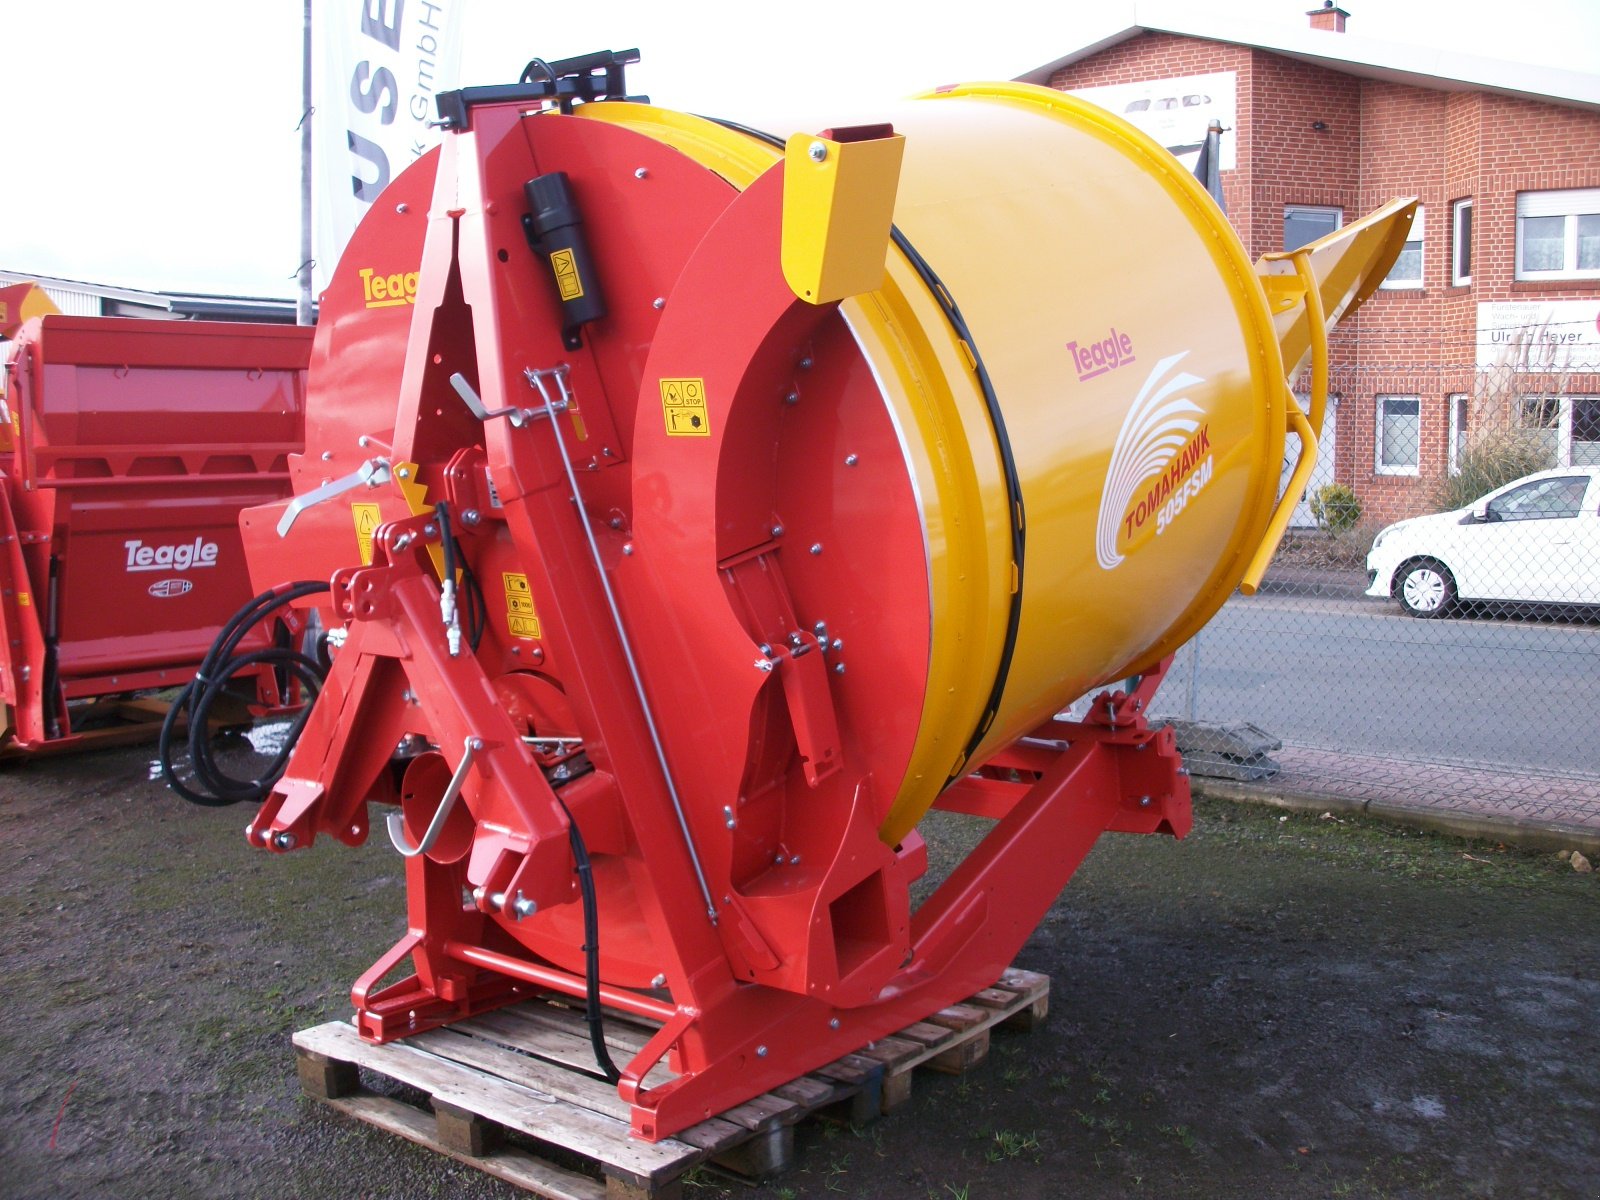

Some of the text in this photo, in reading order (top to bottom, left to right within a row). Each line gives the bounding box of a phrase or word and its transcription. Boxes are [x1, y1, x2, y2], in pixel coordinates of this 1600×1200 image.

[410, 1, 443, 122] GmbH
[358, 267, 420, 305] Teag
[1066, 328, 1134, 377] Teagle
[1125, 424, 1211, 539] TOMAHAWK
[1156, 455, 1213, 536] 505FSM
[124, 536, 219, 571] Teagle
